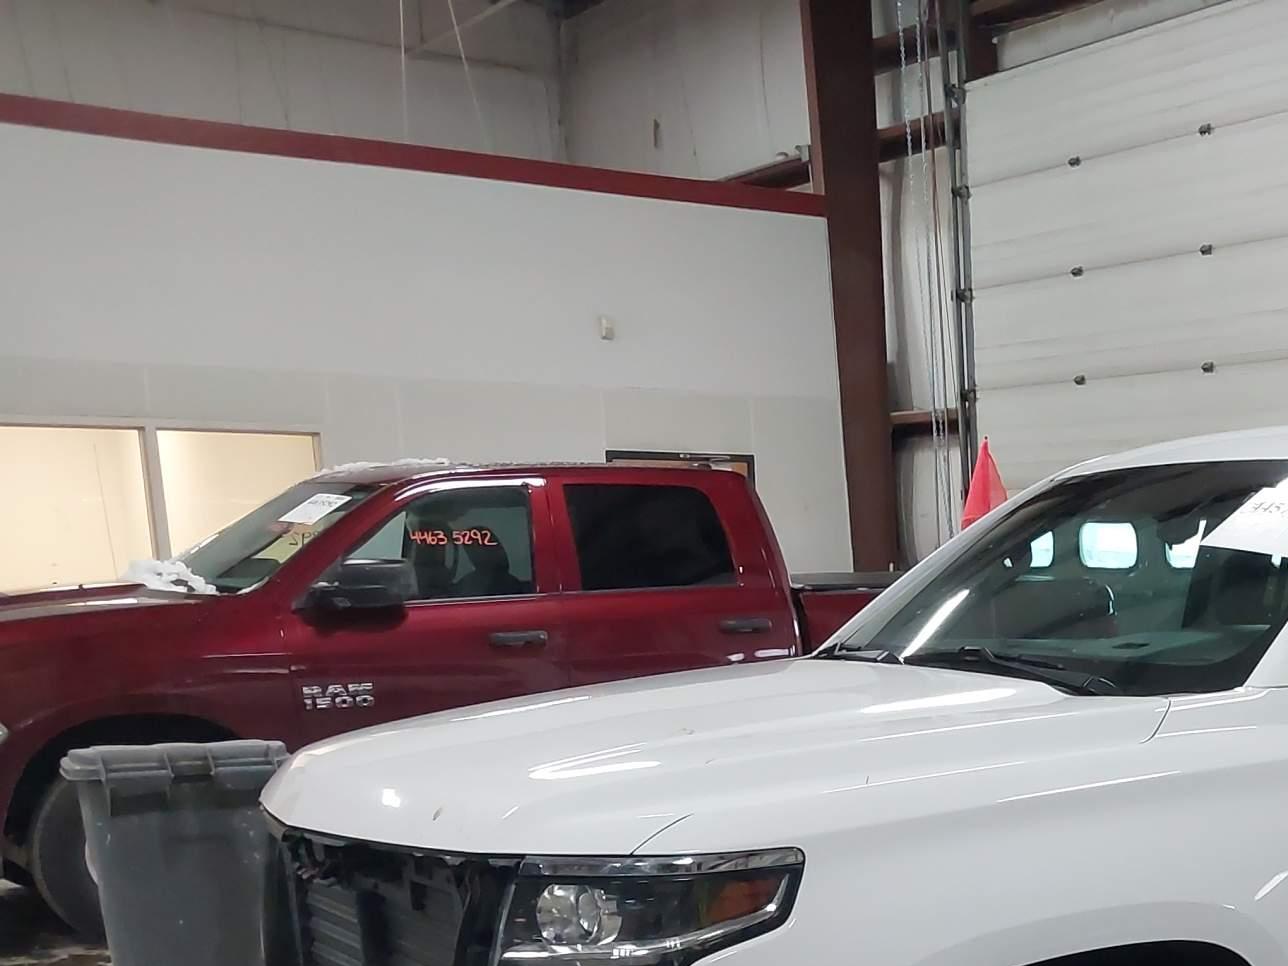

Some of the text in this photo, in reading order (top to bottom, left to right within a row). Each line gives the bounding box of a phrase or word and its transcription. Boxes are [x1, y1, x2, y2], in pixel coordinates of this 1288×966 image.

[408, 529, 498, 545] 4463 5292
[302, 683, 374, 698] RAM
[303, 695, 375, 710] 1500
